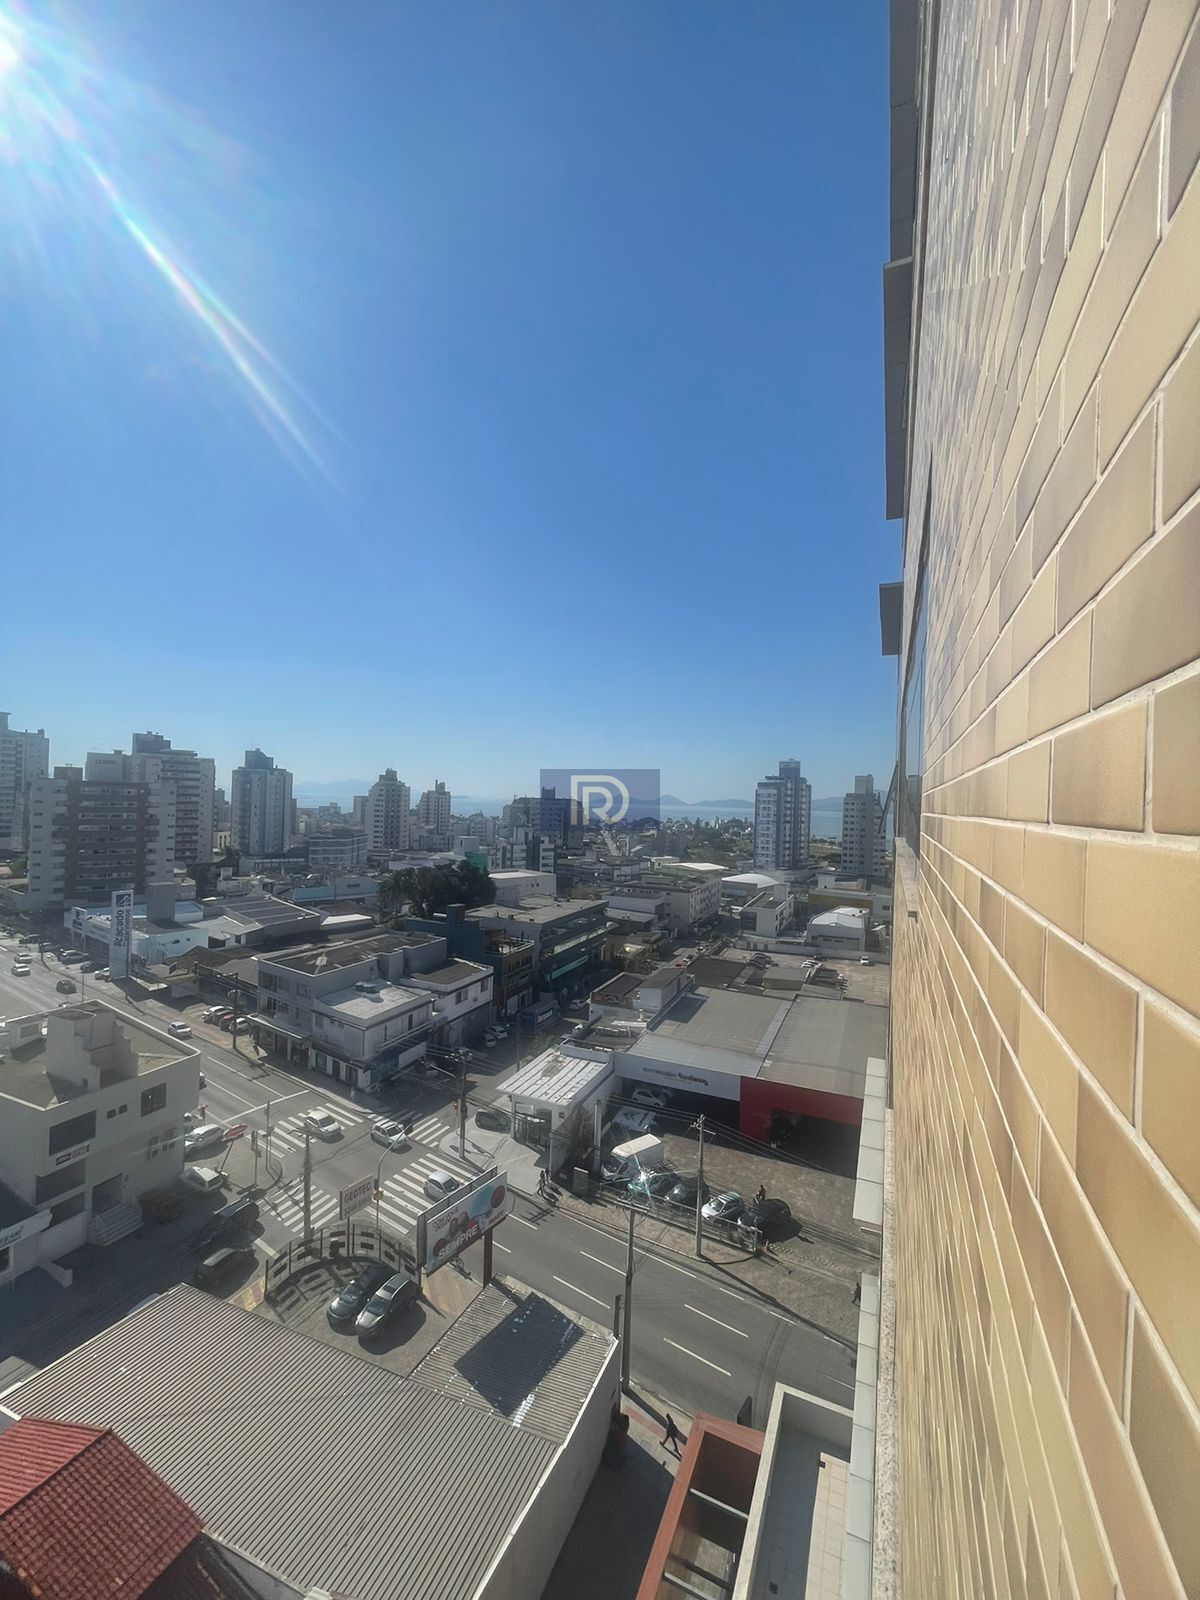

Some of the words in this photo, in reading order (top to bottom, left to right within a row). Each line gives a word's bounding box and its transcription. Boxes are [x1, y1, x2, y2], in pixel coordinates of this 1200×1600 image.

[113, 909, 124, 946] Atacado
[344, 1182, 371, 1203] GEOTEC
[439, 1224, 479, 1258] SEMPRE
